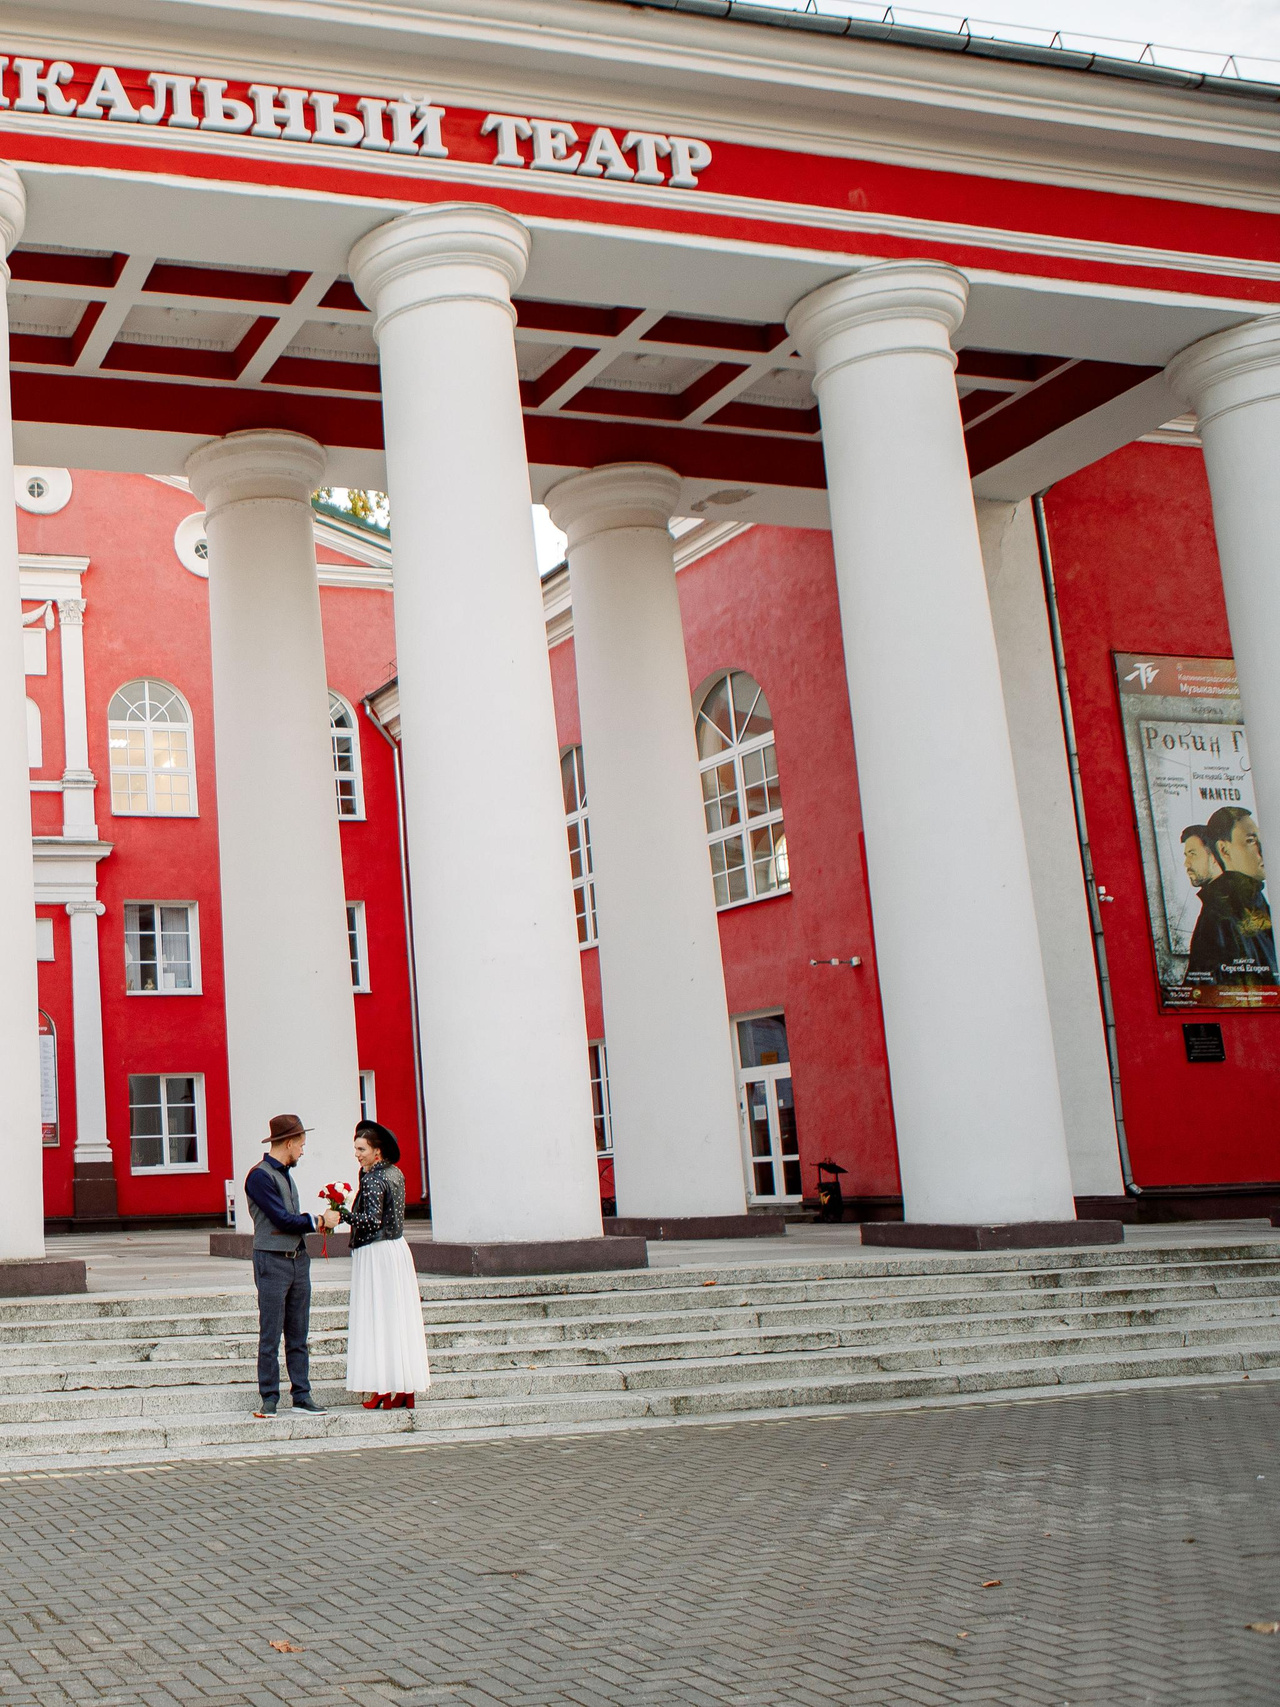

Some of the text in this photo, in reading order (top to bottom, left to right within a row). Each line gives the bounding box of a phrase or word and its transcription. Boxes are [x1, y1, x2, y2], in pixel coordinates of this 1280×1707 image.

[480, 113, 712, 189] ТЕАТР
[1198, 786, 1241, 801] WANTED
[1220, 963, 1245, 974] Сергей
[1245, 964, 1270, 974] Егоров
